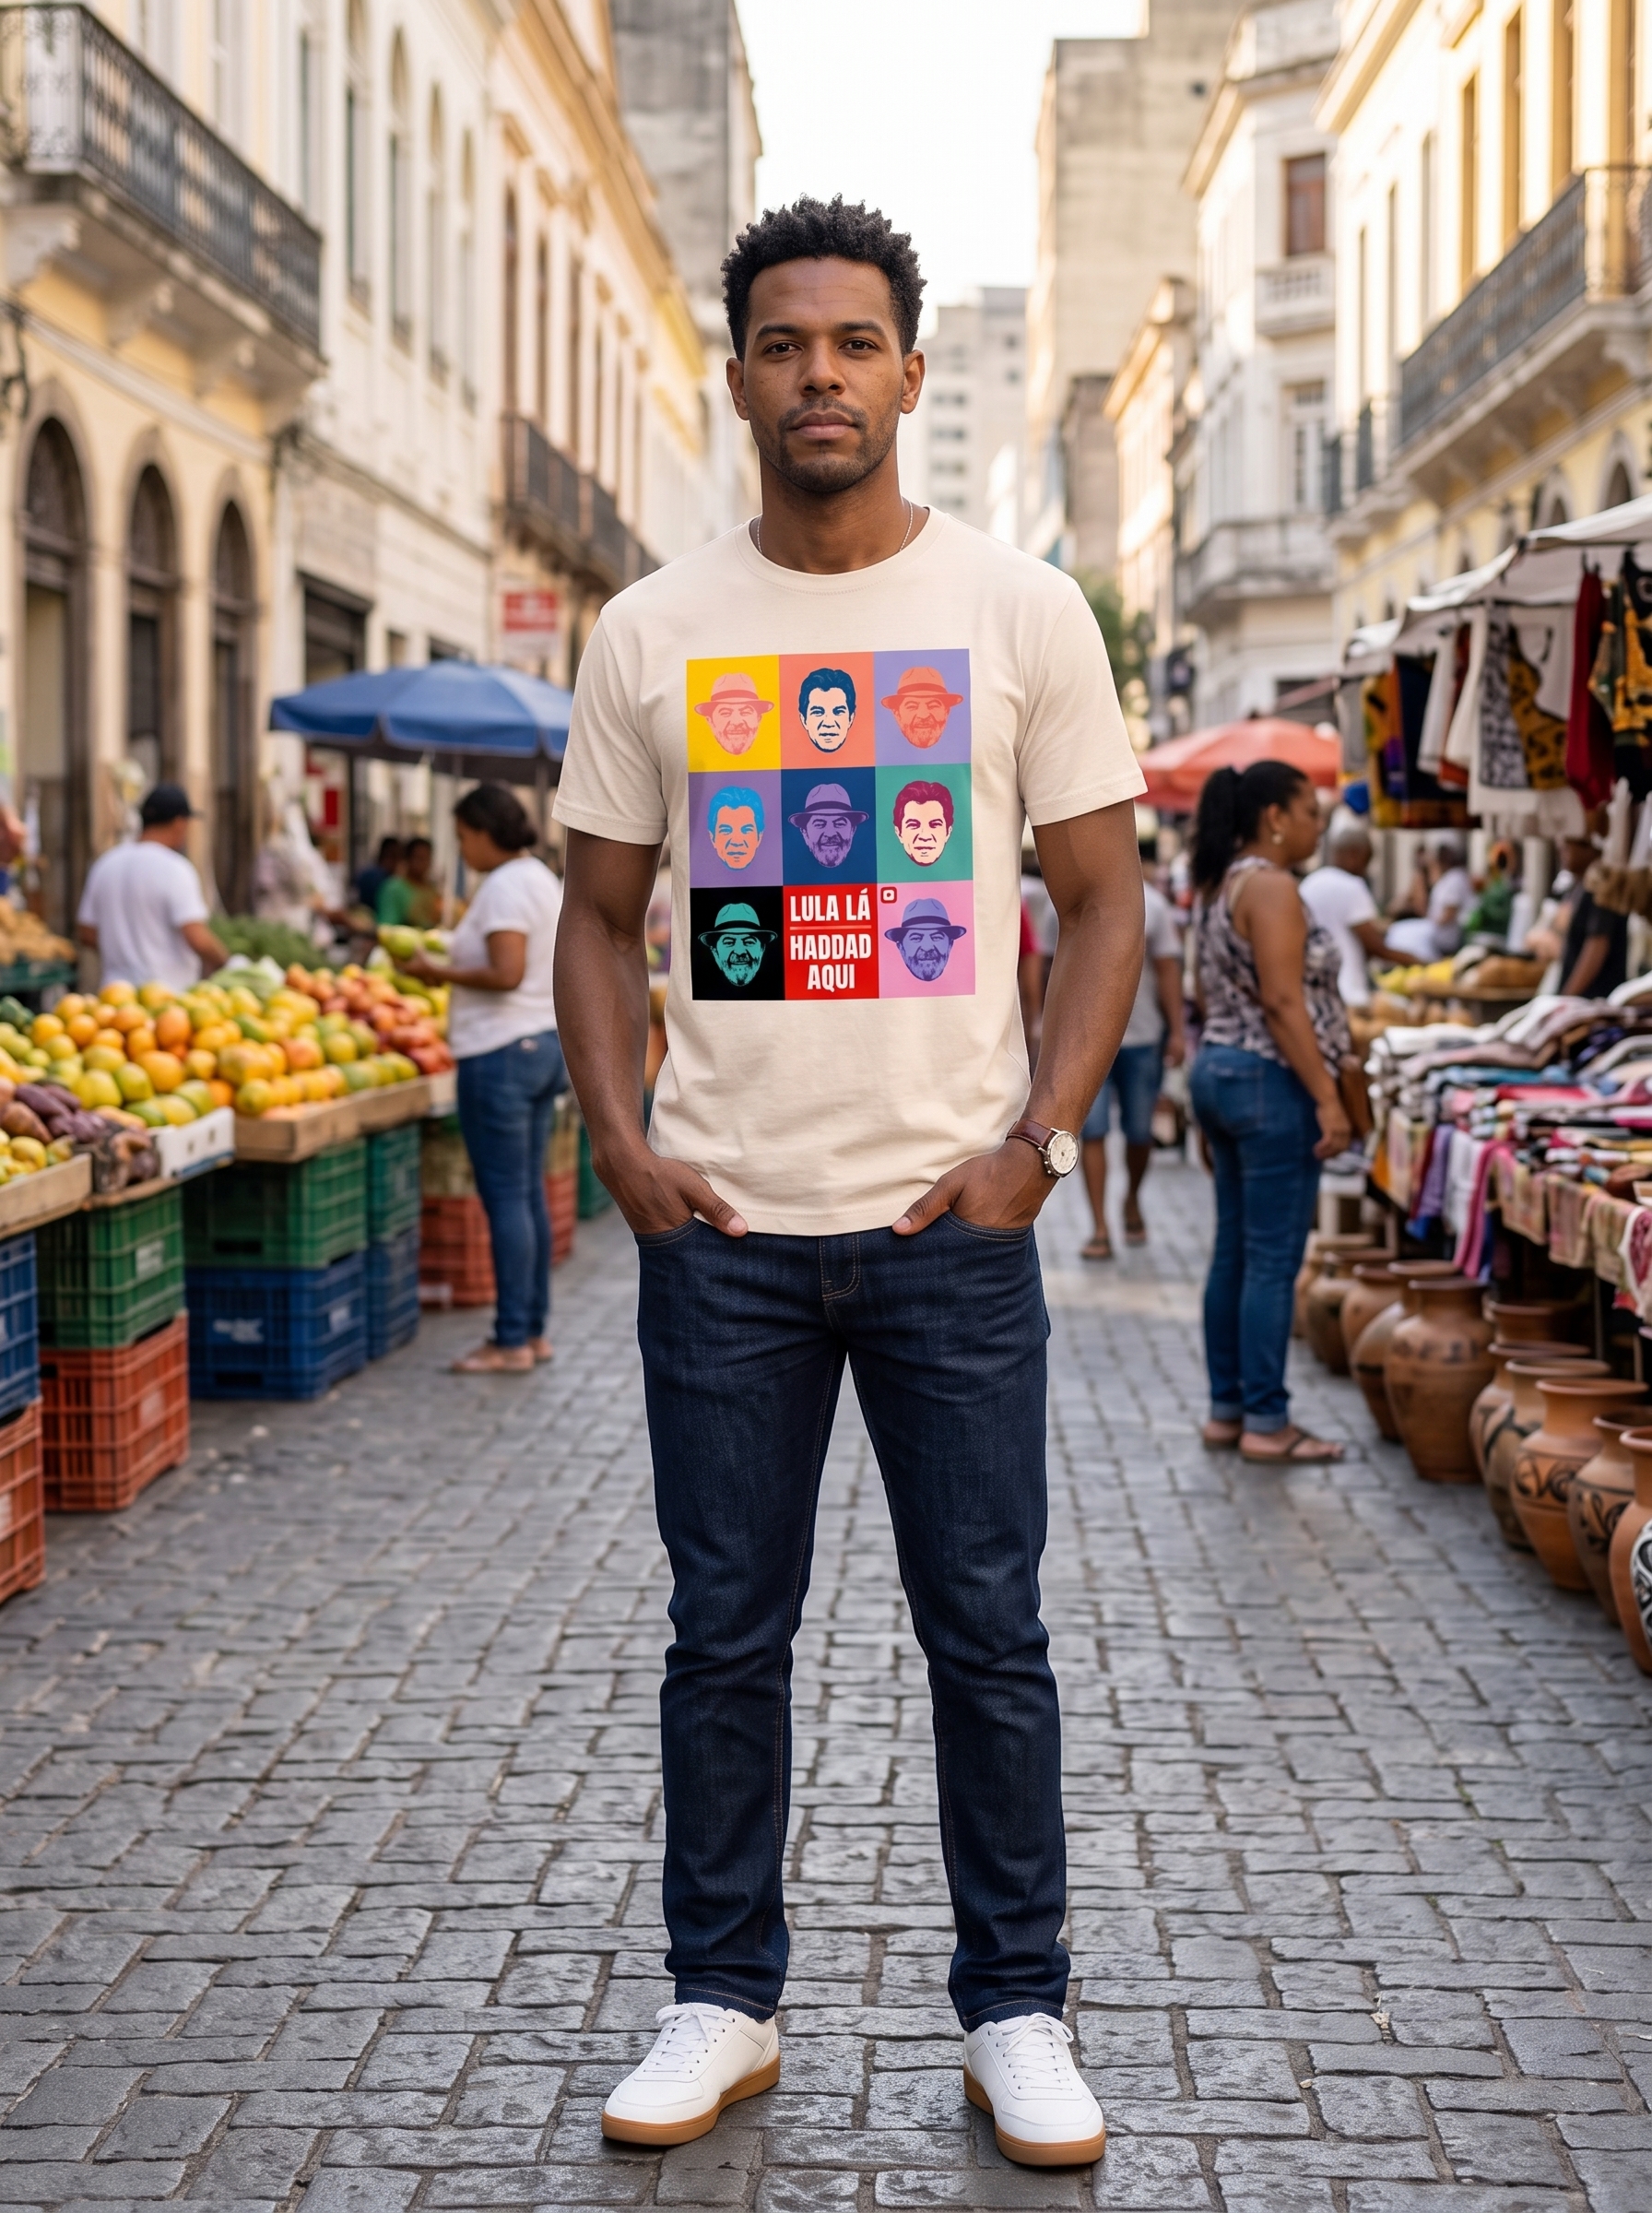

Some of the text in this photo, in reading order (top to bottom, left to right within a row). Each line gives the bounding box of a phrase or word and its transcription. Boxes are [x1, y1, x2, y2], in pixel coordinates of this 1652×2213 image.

[790, 887, 871, 922] LULA LÁ
[789, 933, 872, 961] HADDAD
[807, 964, 856, 993] AQUI
